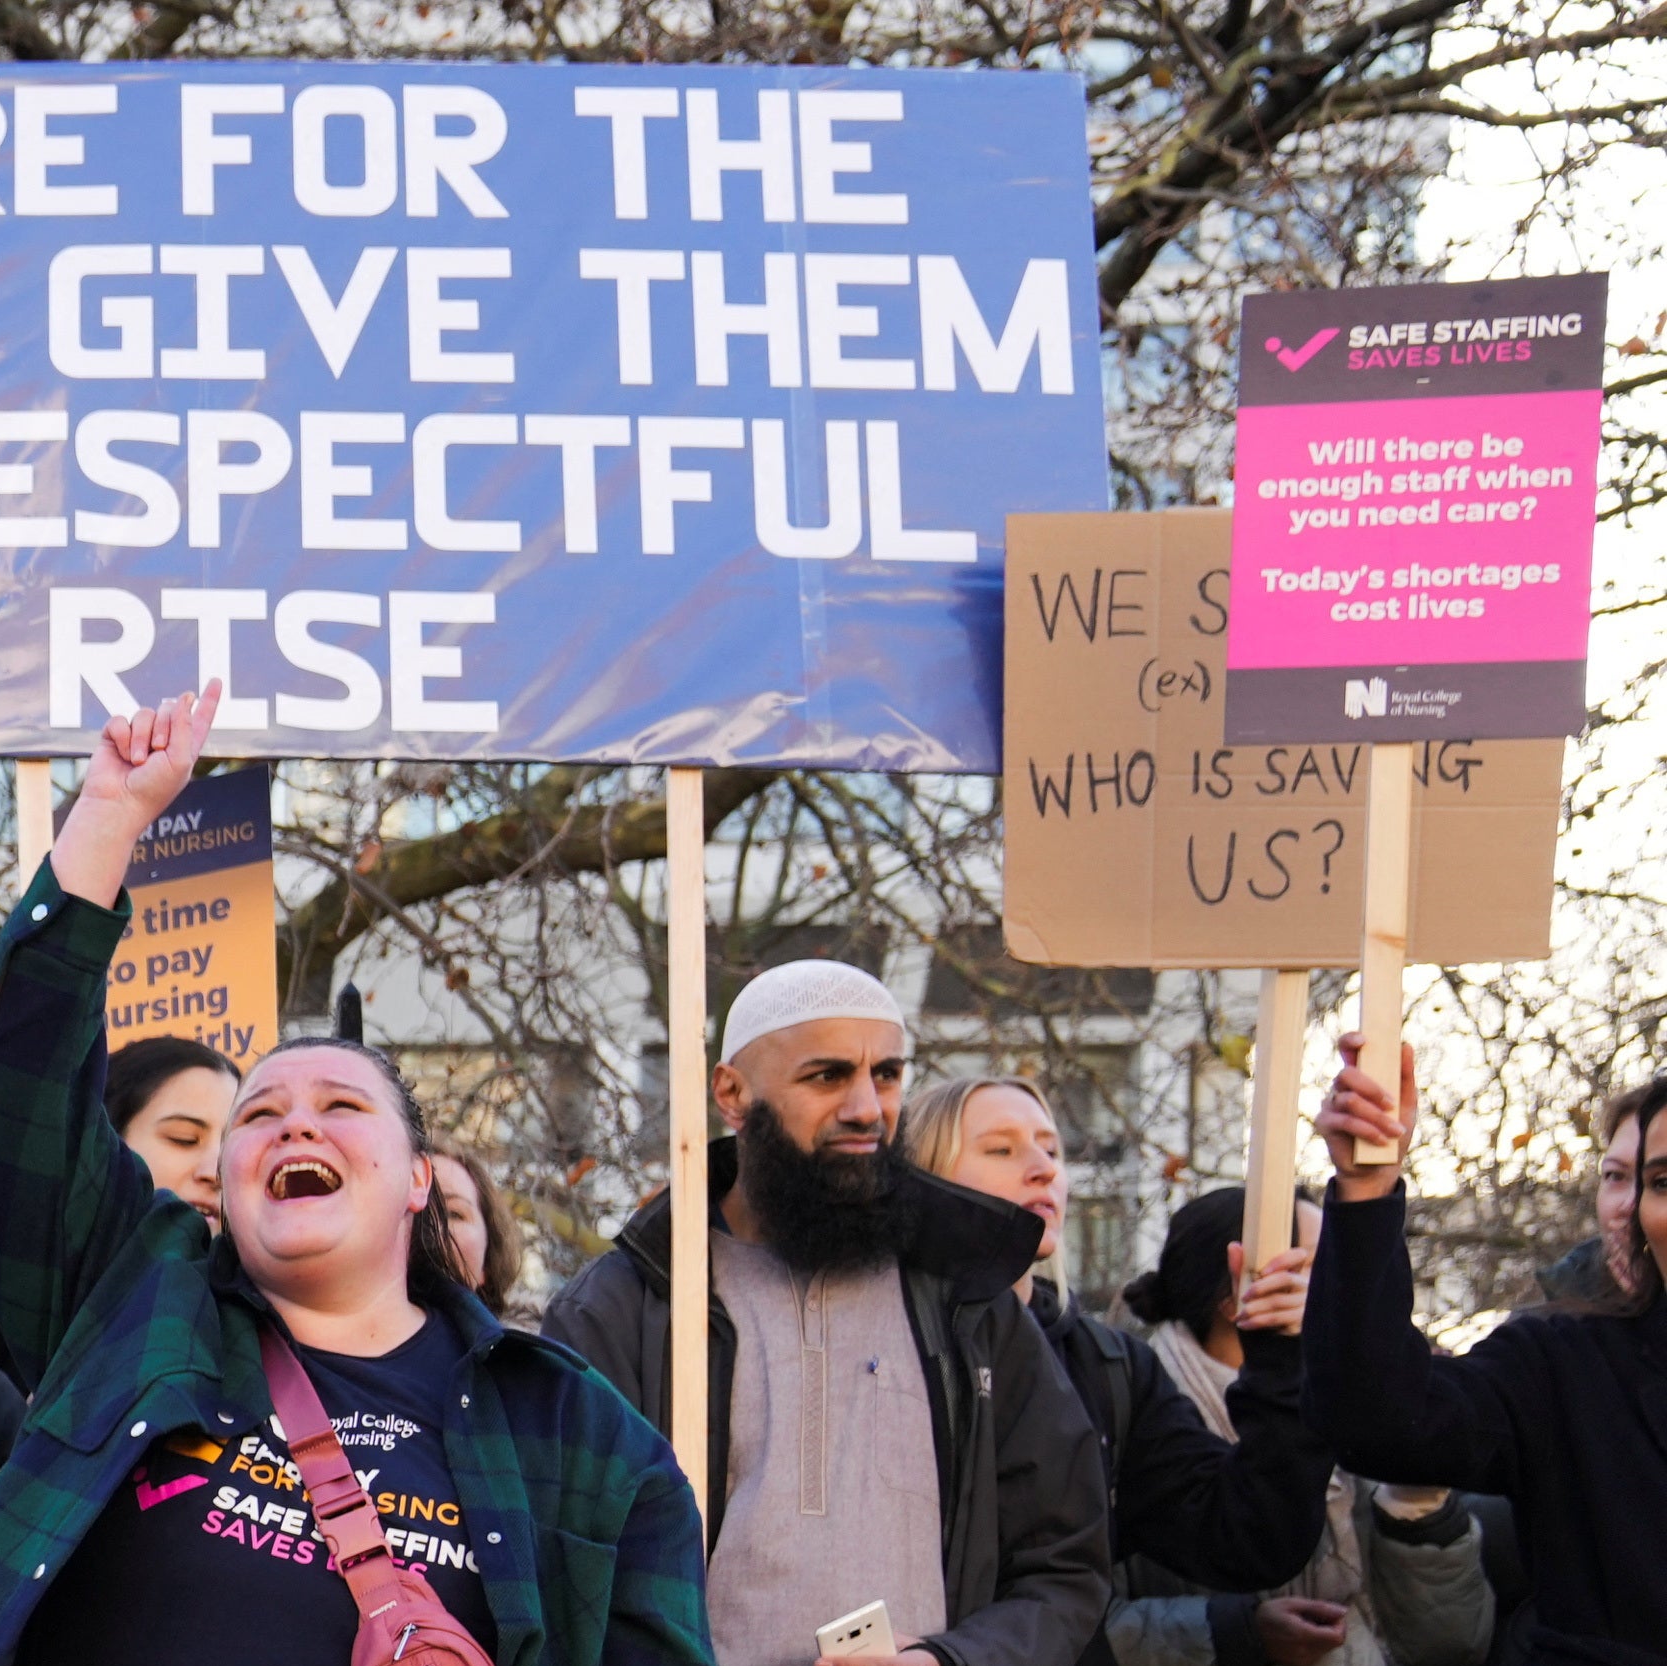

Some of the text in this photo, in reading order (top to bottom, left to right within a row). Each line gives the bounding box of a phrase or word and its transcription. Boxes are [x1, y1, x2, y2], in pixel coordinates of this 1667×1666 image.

[181, 84, 510, 218] FOR
[574, 86, 909, 224] THE
[48, 244, 515, 383] GIVE
[579, 248, 1074, 395] THEM
[1348, 312, 1583, 349] SAFE STAFFING
[1348, 340, 1532, 371] SAVES LIVES
[1308, 433, 1524, 465] Will there be
[1258, 463, 1573, 502] enough staff when
[1289, 496, 1538, 535] you need care?
[1261, 560, 1561, 597] Today's shortages
[1030, 568, 1147, 644] WE
[1330, 594, 1486, 623] cost lives
[48, 587, 499, 733] RISE
[1138, 657, 1212, 713] (ex)
[1391, 689, 1462, 706] Royal College
[1390, 703, 1446, 719] of Nursing
[1028, 749, 1234, 819] WHO IS
[154, 821, 255, 859] NURSING
[158, 808, 204, 838] PAY
[1188, 819, 1345, 907] US?
[142, 897, 231, 936] time
[146, 943, 214, 987] pay
[361, 1413, 422, 1440] College
[229, 1453, 296, 1492] FOR
[213, 1486, 307, 1536] SAFE
[201, 1511, 316, 1564] SAVES
